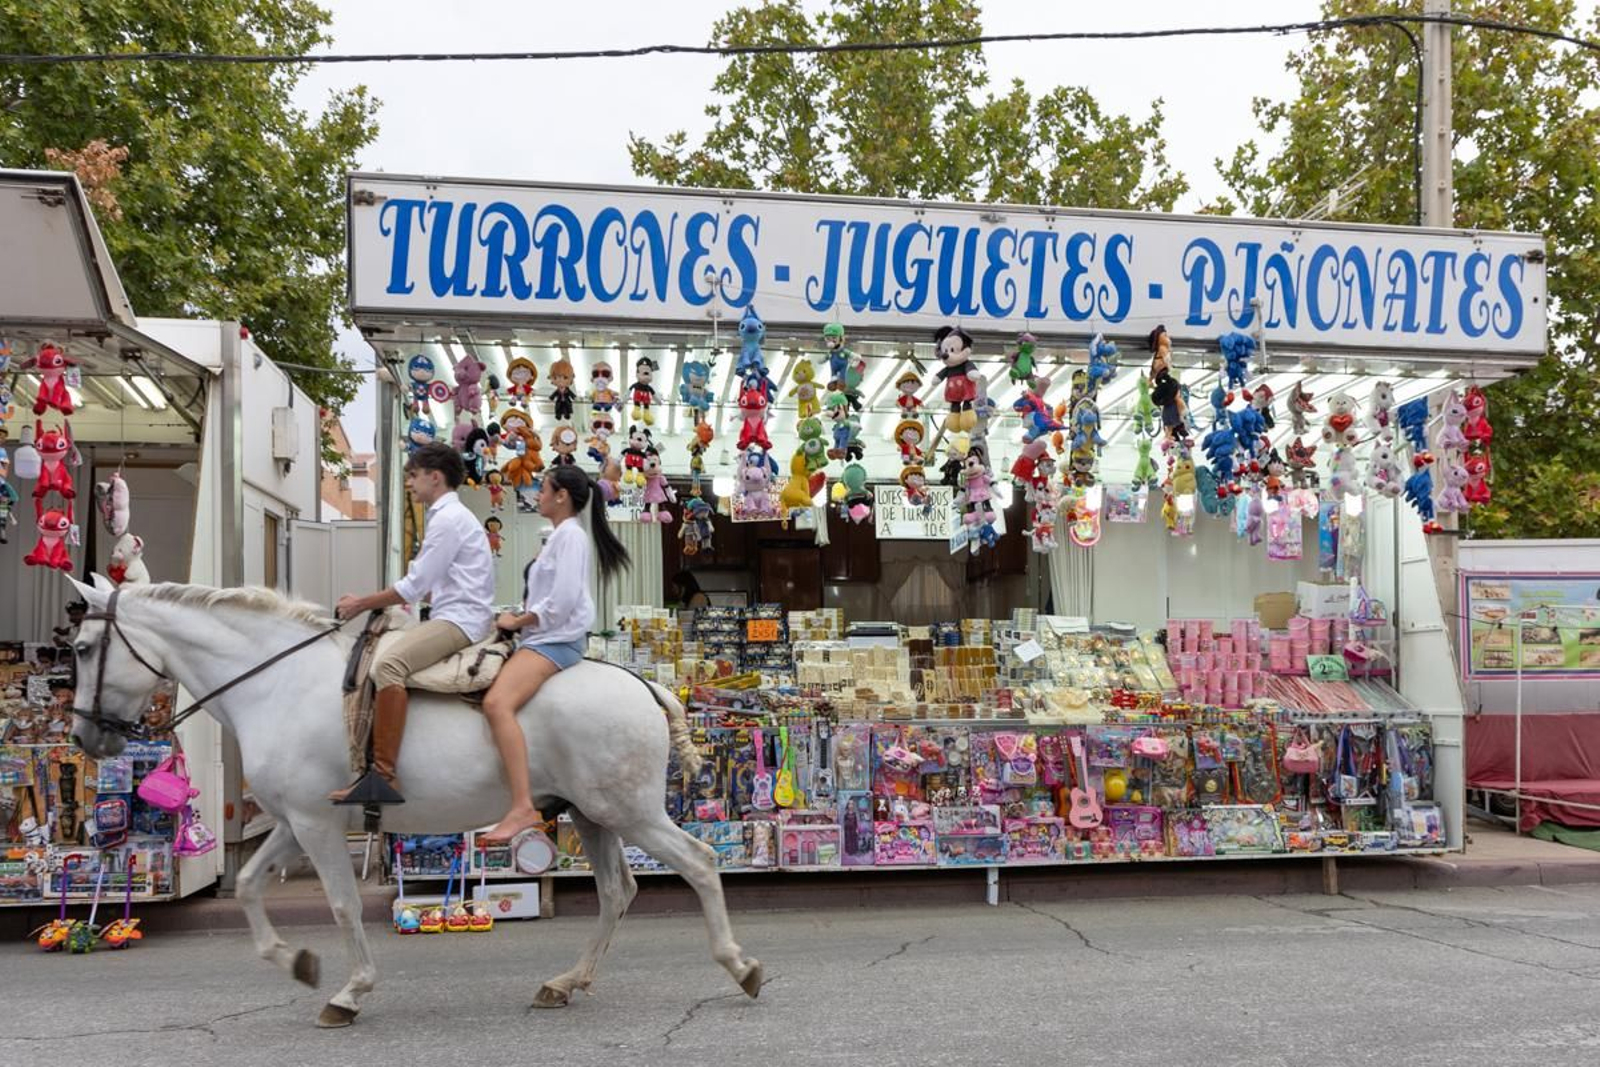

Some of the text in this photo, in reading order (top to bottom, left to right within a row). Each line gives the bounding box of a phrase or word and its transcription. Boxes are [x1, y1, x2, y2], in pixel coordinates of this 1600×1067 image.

[379, 197, 762, 308] TURRONES
[806, 219, 1133, 324] JUGUETES
[1182, 237, 1526, 340] PIÑONATES
[882, 506, 896, 520] DE
[881, 522, 891, 535] A
